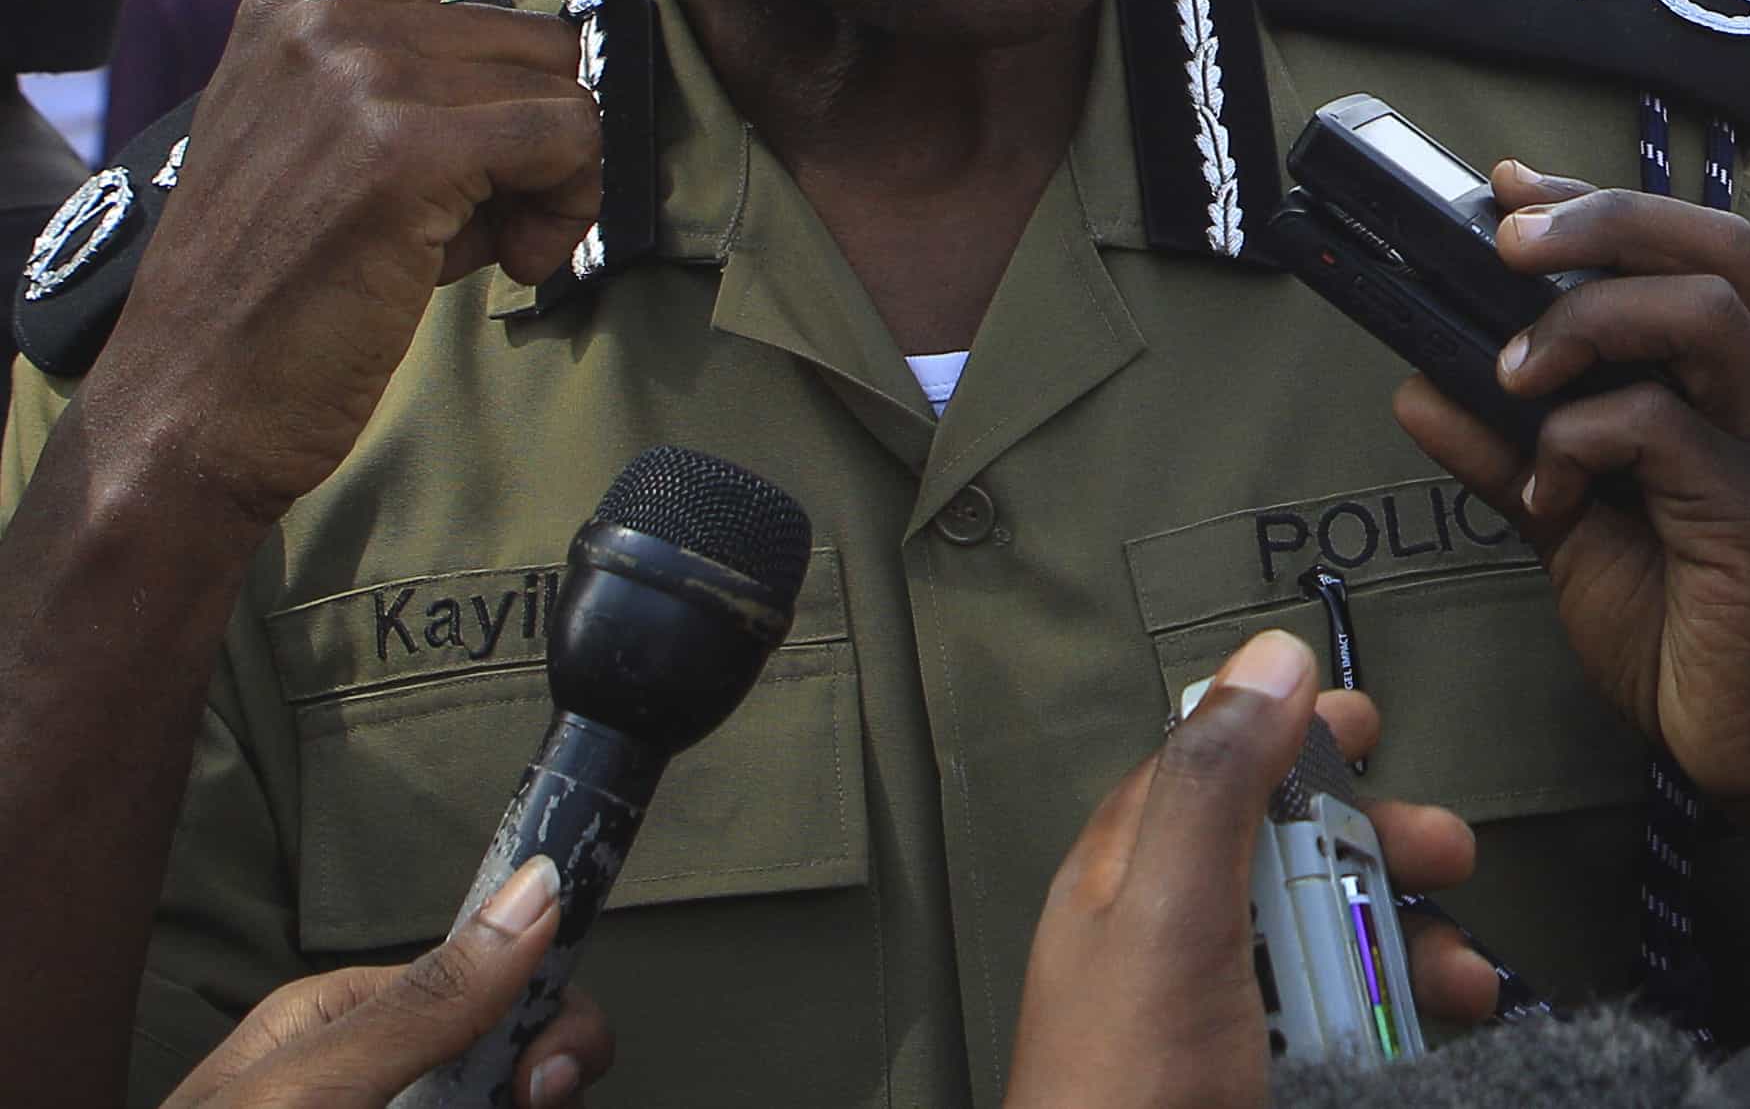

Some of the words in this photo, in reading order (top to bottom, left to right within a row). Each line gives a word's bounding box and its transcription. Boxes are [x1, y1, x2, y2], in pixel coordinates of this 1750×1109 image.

[1256, 485, 1513, 582] POLIC
[1338, 633, 1352, 668] IMPACT
[1343, 668, 1354, 690] GEL
